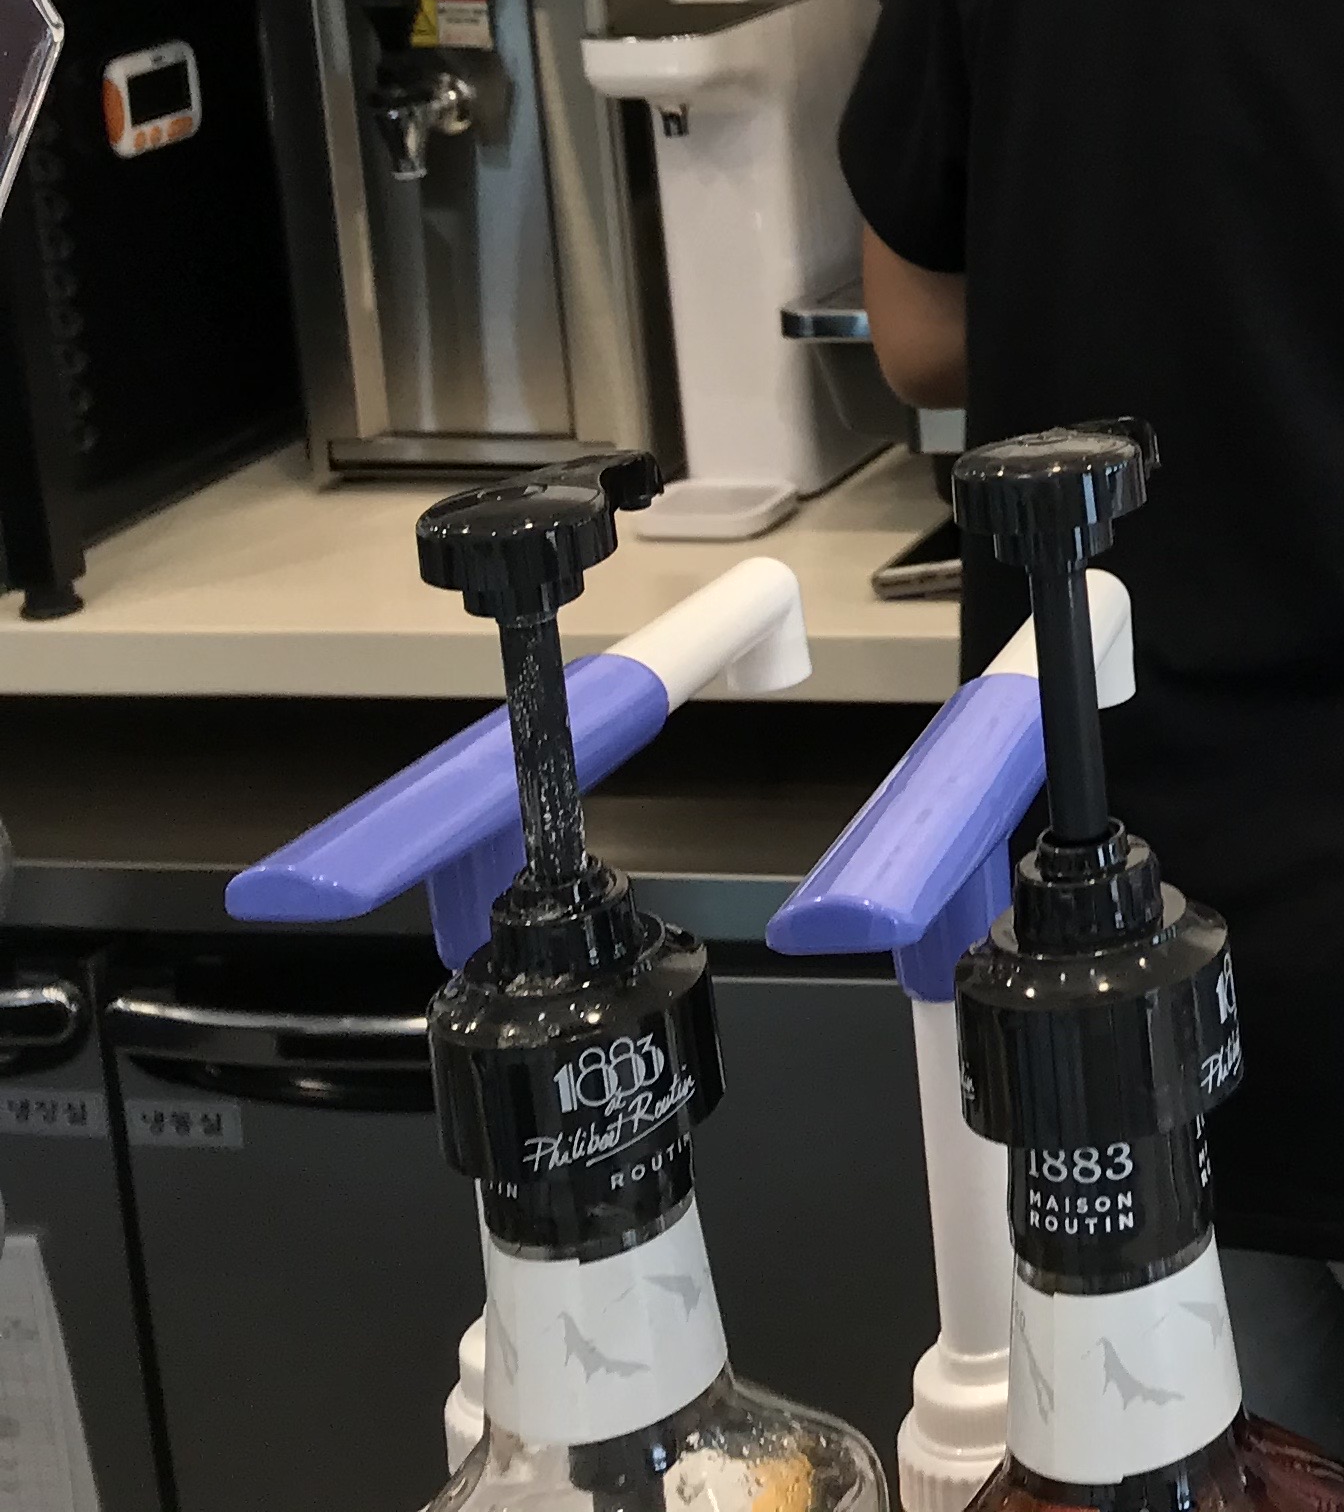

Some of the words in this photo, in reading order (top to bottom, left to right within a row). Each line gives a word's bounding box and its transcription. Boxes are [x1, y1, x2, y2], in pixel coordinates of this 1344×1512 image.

[553, 1032, 665, 1113] 1883
[1028, 1141, 1135, 1185] 1883
[1029, 1189, 1134, 1215] MAISON
[1029, 1211, 1136, 1236] ROUTIN
